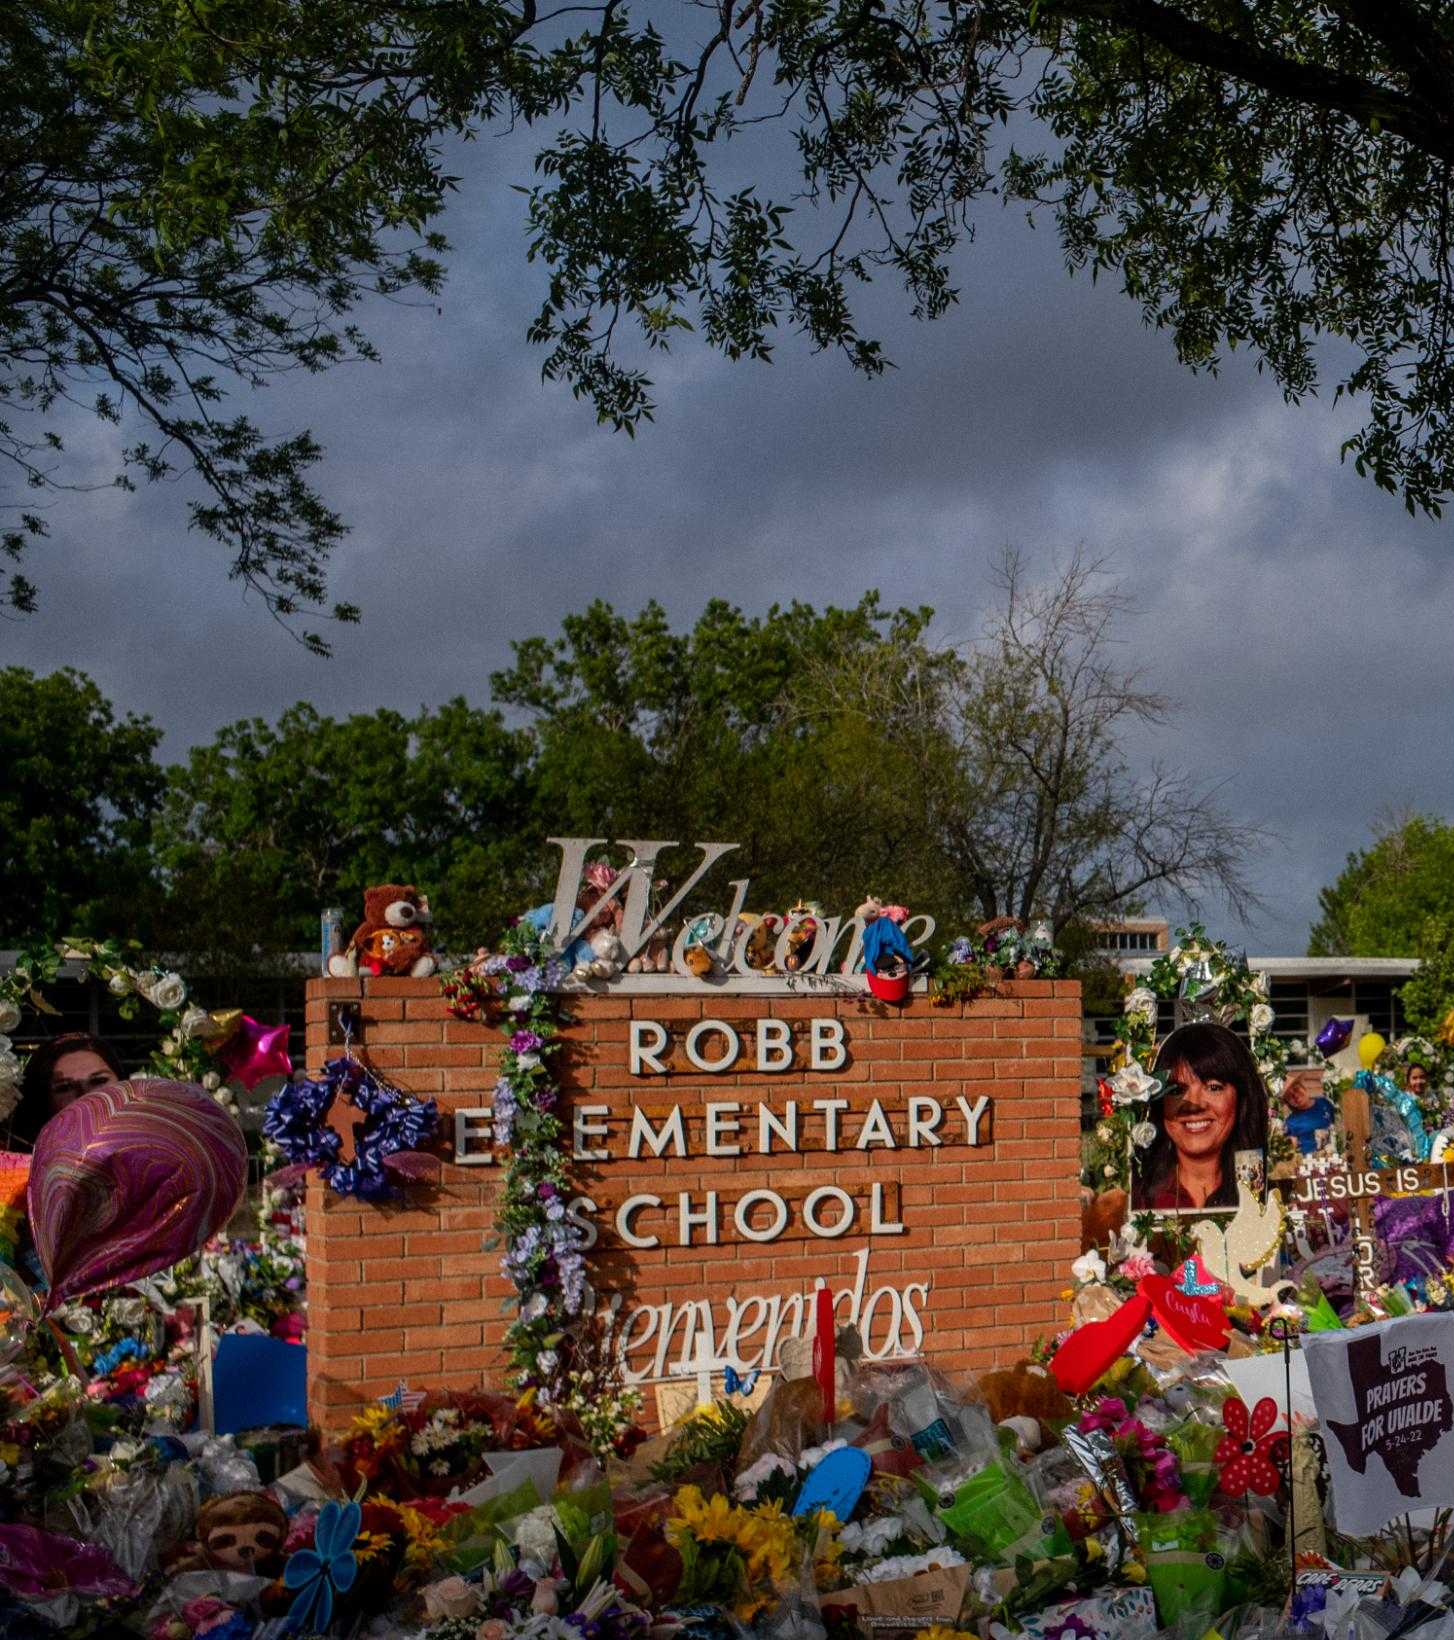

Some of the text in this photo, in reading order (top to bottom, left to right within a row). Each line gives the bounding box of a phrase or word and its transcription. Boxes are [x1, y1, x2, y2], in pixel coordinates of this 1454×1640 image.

[630, 1018, 848, 1075] ROBB
[454, 1095, 990, 1165] EEMENTARY
[1297, 1168, 1420, 1202] JESUS IS
[572, 1183, 905, 1252] SCHOOL
[1355, 1217, 1376, 1298] LOR
[584, 1248, 930, 1382] ienvenidos
[1366, 1372, 1428, 1414] PRAYERS
[1361, 1398, 1444, 1452] FOR UVALDE
[1385, 1429, 1425, 1451] 5-24-22
